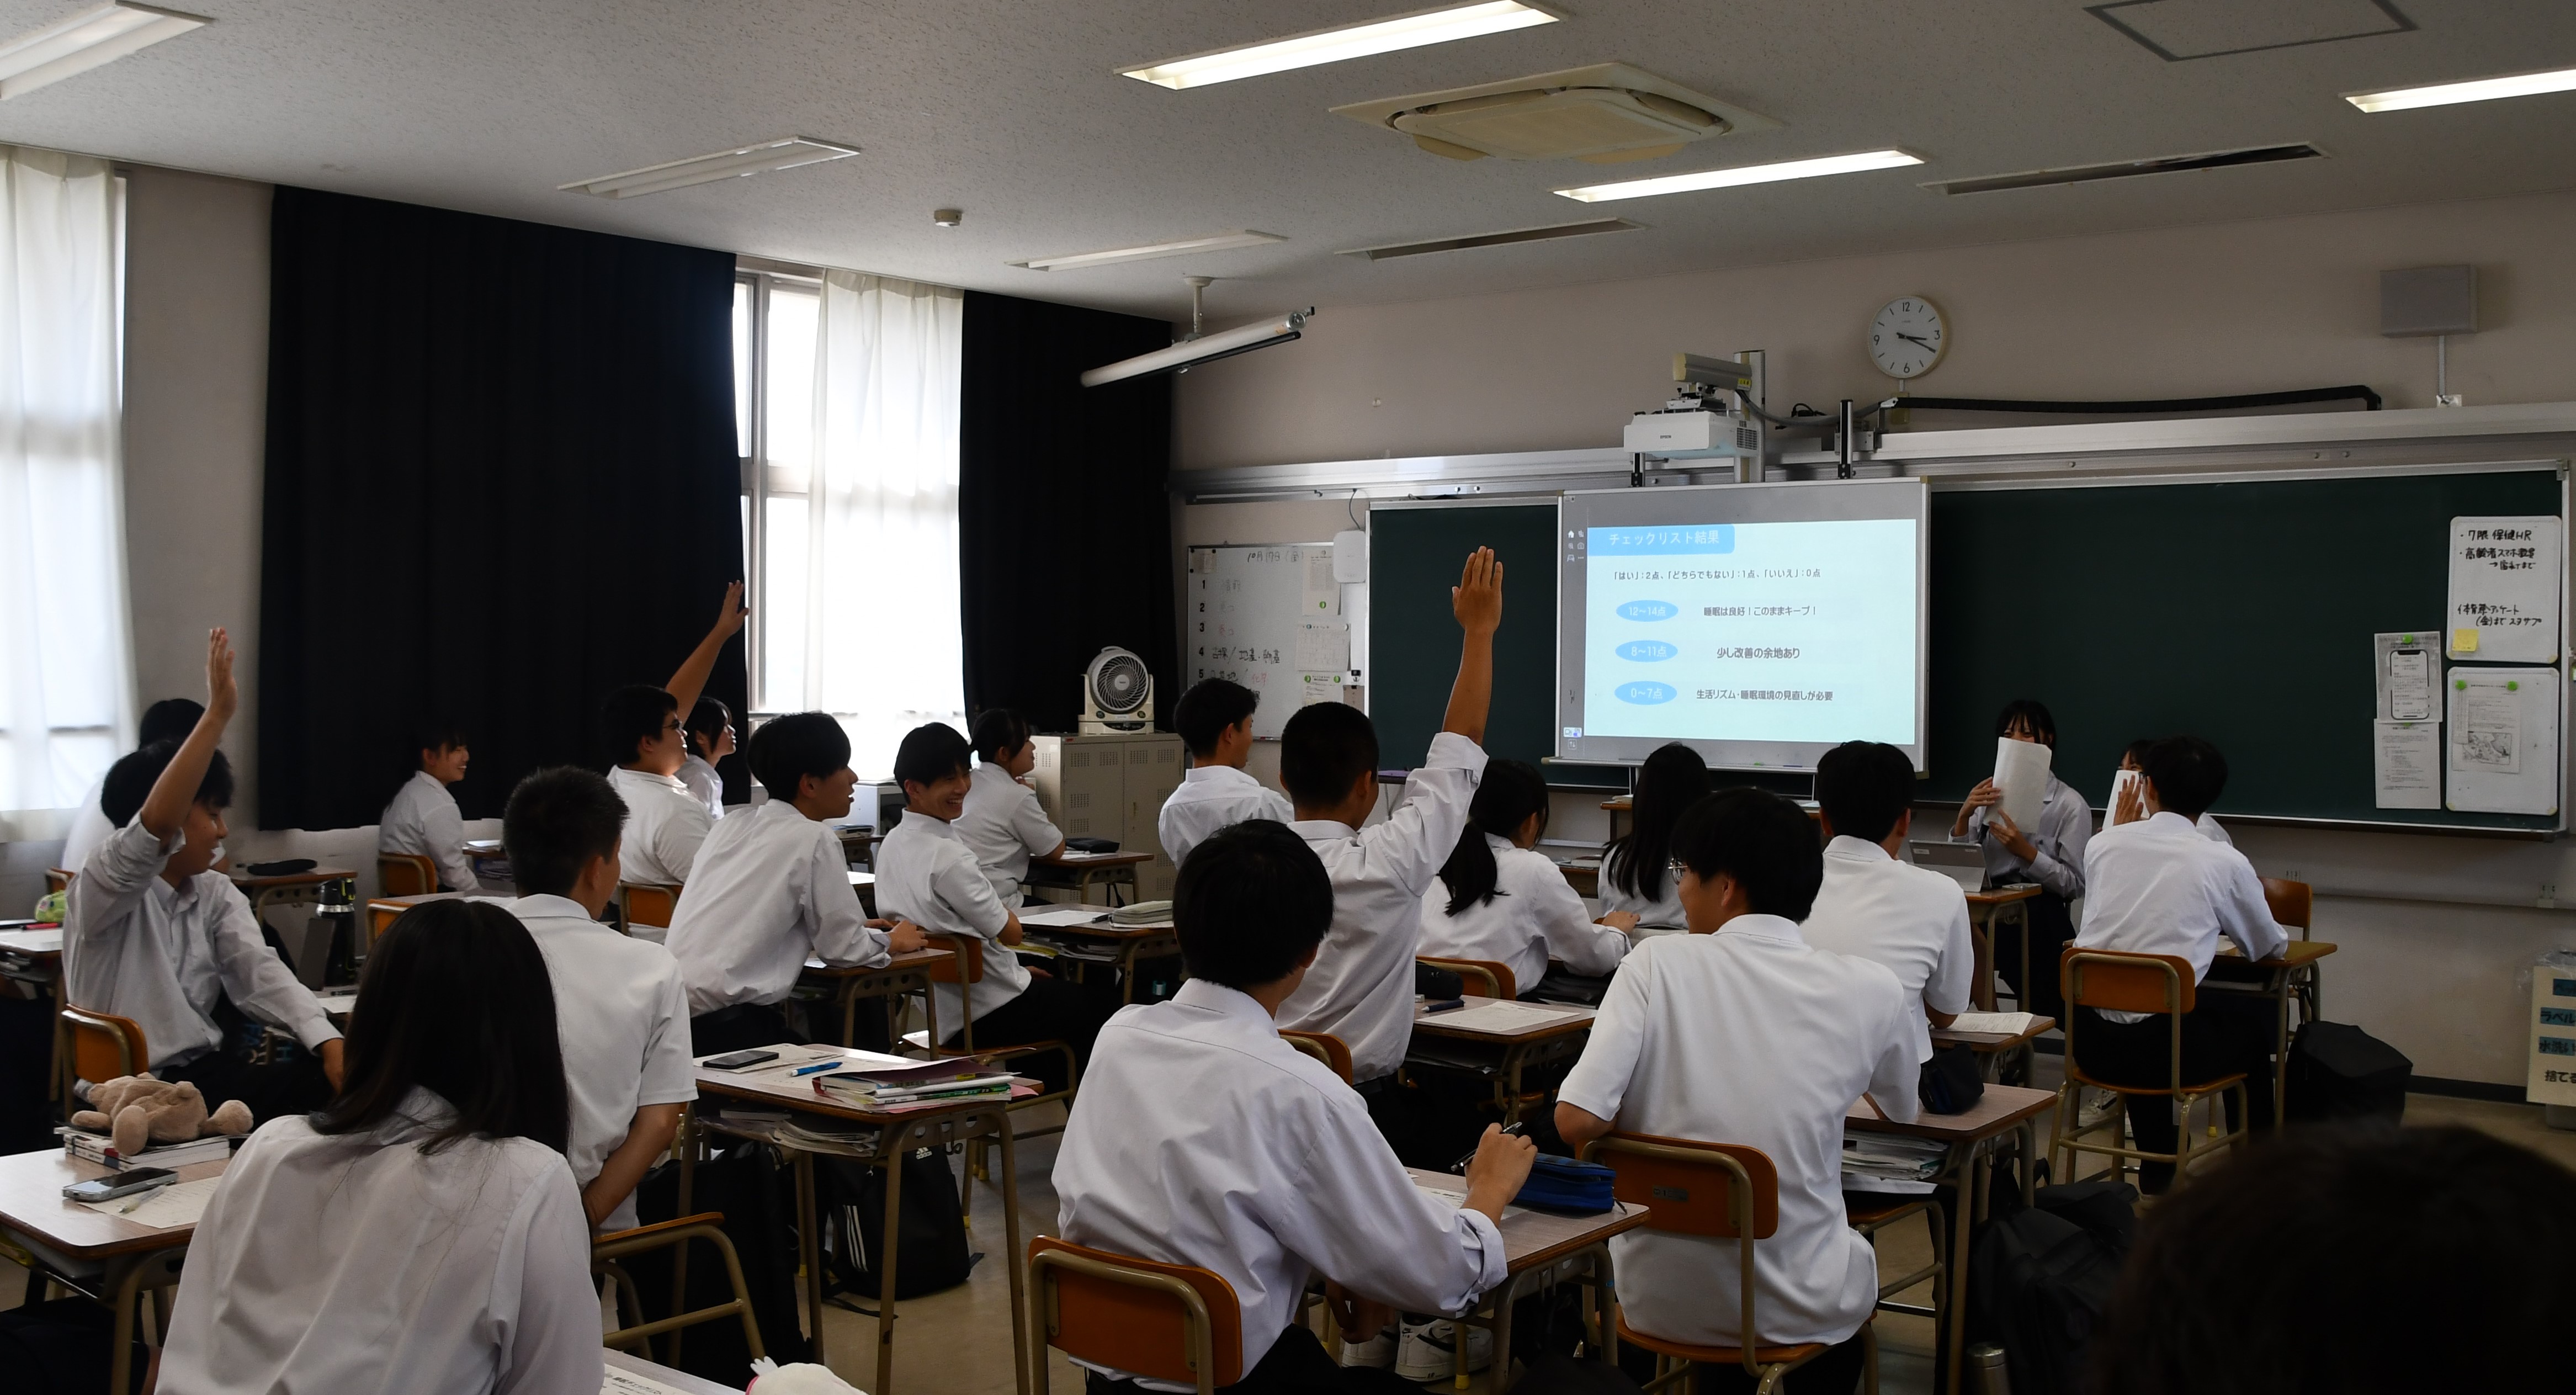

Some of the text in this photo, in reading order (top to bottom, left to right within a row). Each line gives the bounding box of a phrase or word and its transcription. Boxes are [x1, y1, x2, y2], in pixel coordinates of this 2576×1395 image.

[1903, 302, 1910, 312] 12
[1934, 330, 1940, 340] 3
[1874, 335, 1880, 346] 9
[1904, 363, 1910, 373] 6
[1609, 530, 1719, 545] チェックリスト結果
[2492, 529, 2532, 541] 保健HR
[1202, 580, 1205, 589] 1
[1199, 602, 1205, 612] 2
[1199, 622, 1204, 632] 3
[1199, 647, 1204, 656] 4
[1717, 647, 1800, 659] 少し改善の余地あり
[1199, 669, 1204, 678] 5
[1696, 689, 1833, 701] 生活リズム・睡眠環境の見直しが必要
